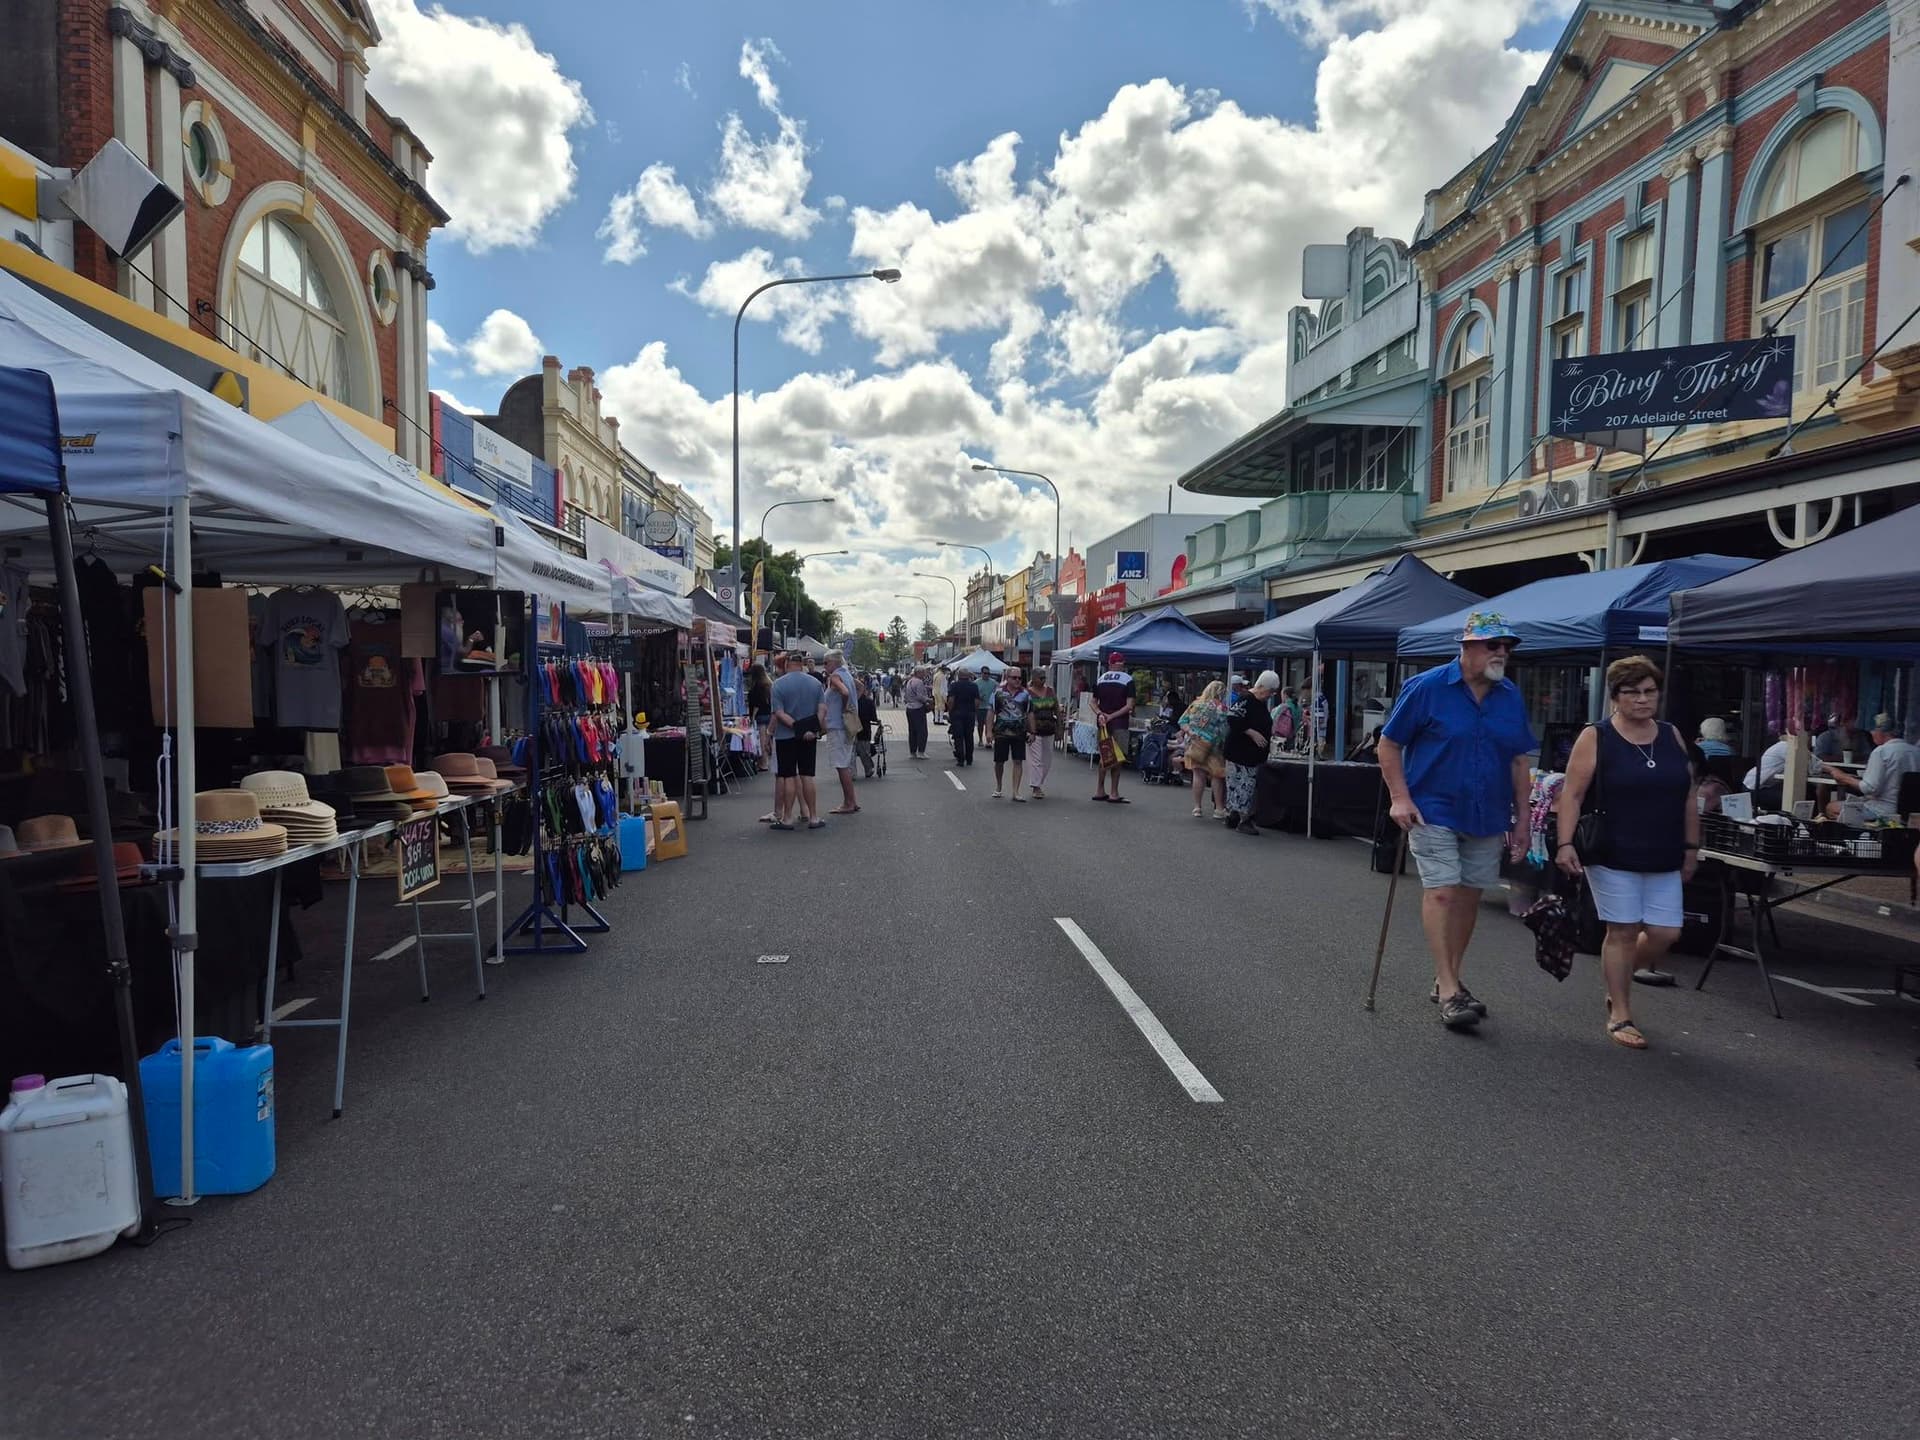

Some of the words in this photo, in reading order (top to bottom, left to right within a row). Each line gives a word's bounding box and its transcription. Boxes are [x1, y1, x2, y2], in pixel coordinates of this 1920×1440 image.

[1561, 363, 1584, 377] The
[1673, 351, 1770, 403] Thing
[1570, 366, 1664, 415] Bling
[1605, 415, 1628, 427] 207
[1631, 410, 1686, 425] Adelaide
[1689, 408, 1728, 420] Street
[1121, 570, 1142, 578] ANZ
[405, 820, 432, 842] HATS
[407, 842, 422, 867] $69
